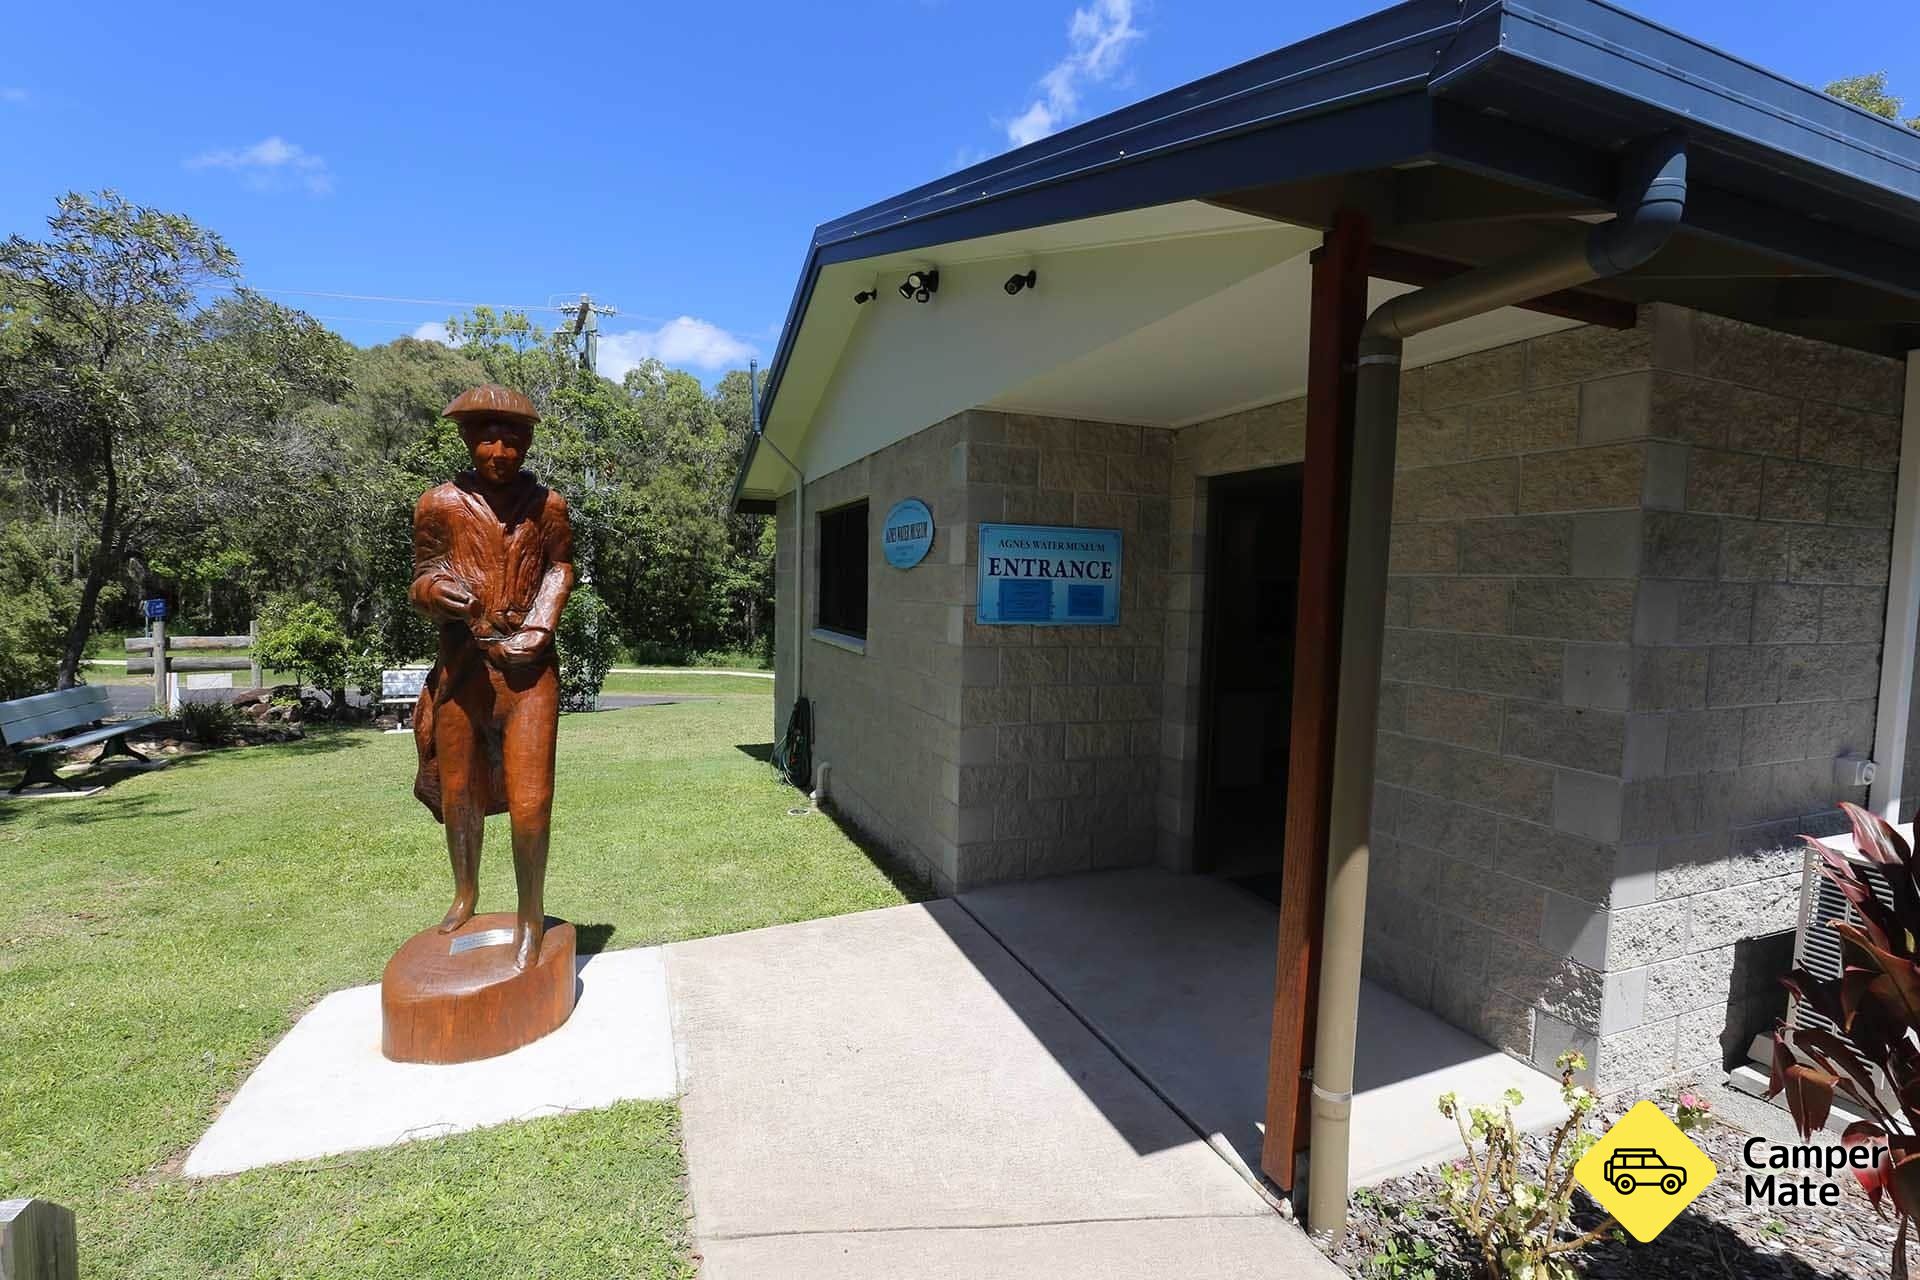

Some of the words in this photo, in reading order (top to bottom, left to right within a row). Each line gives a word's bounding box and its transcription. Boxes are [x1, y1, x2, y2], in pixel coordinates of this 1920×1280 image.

[999, 539, 1030, 550] AGNES
[1032, 540, 1065, 551] WATER
[1065, 542, 1105, 552] MUSEUM
[988, 557, 1113, 580] ENTRANCE
